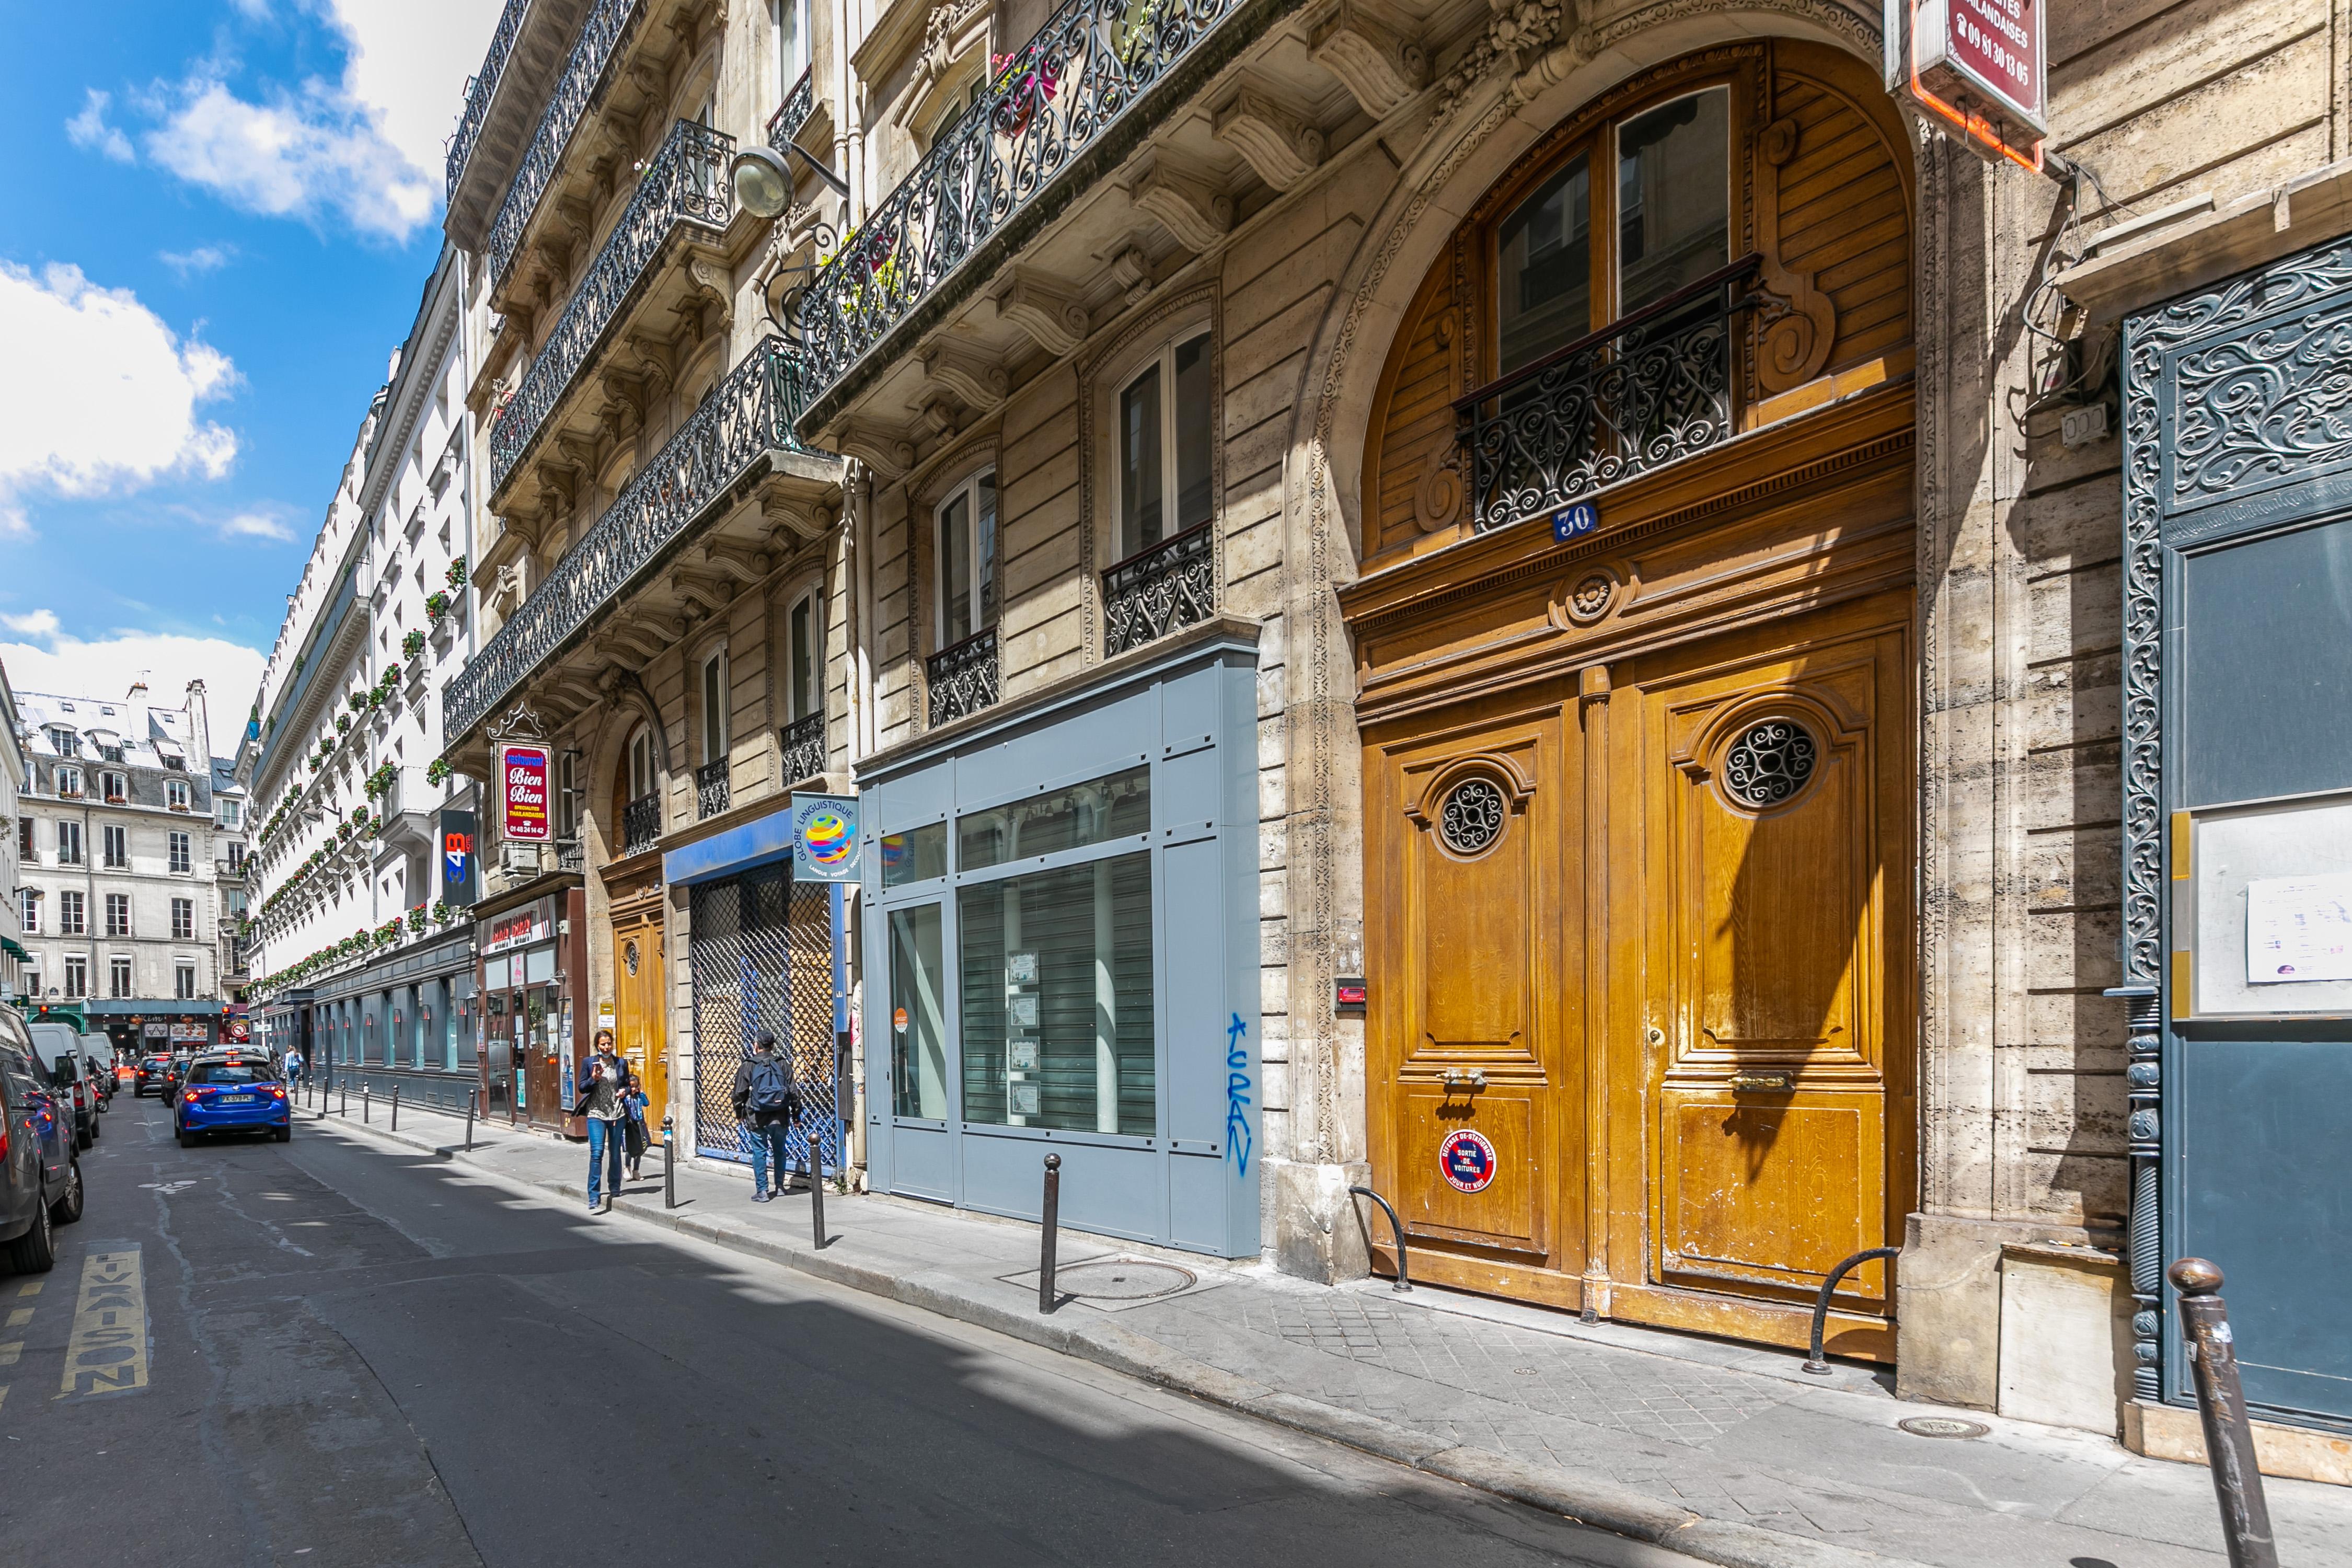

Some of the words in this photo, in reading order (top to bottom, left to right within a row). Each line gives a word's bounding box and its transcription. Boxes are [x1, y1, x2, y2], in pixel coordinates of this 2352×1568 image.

[1968, 22, 1980, 49] 09
[1982, 33, 1992, 59] 81
[1993, 42, 2005, 68] 30
[2005, 53, 2015, 76] 13
[2016, 61, 2028, 86] 05
[1558, 506, 1589, 536] 30
[506, 754, 544, 766] restaurant
[509, 767, 543, 786] Bien
[510, 785, 543, 804] Bien
[798, 800, 854, 825] LINGUISTIQUE
[794, 827, 806, 861] GLOBE
[446, 833, 466, 884] 34B
[809, 864, 827, 877] LANGUE
[830, 868, 849, 878] VOYAGE
[1455, 1165, 1481, 1173] VOITURES
[1449, 1175, 1463, 1188] JOUR
[1472, 1178, 1485, 1189] NUIT
